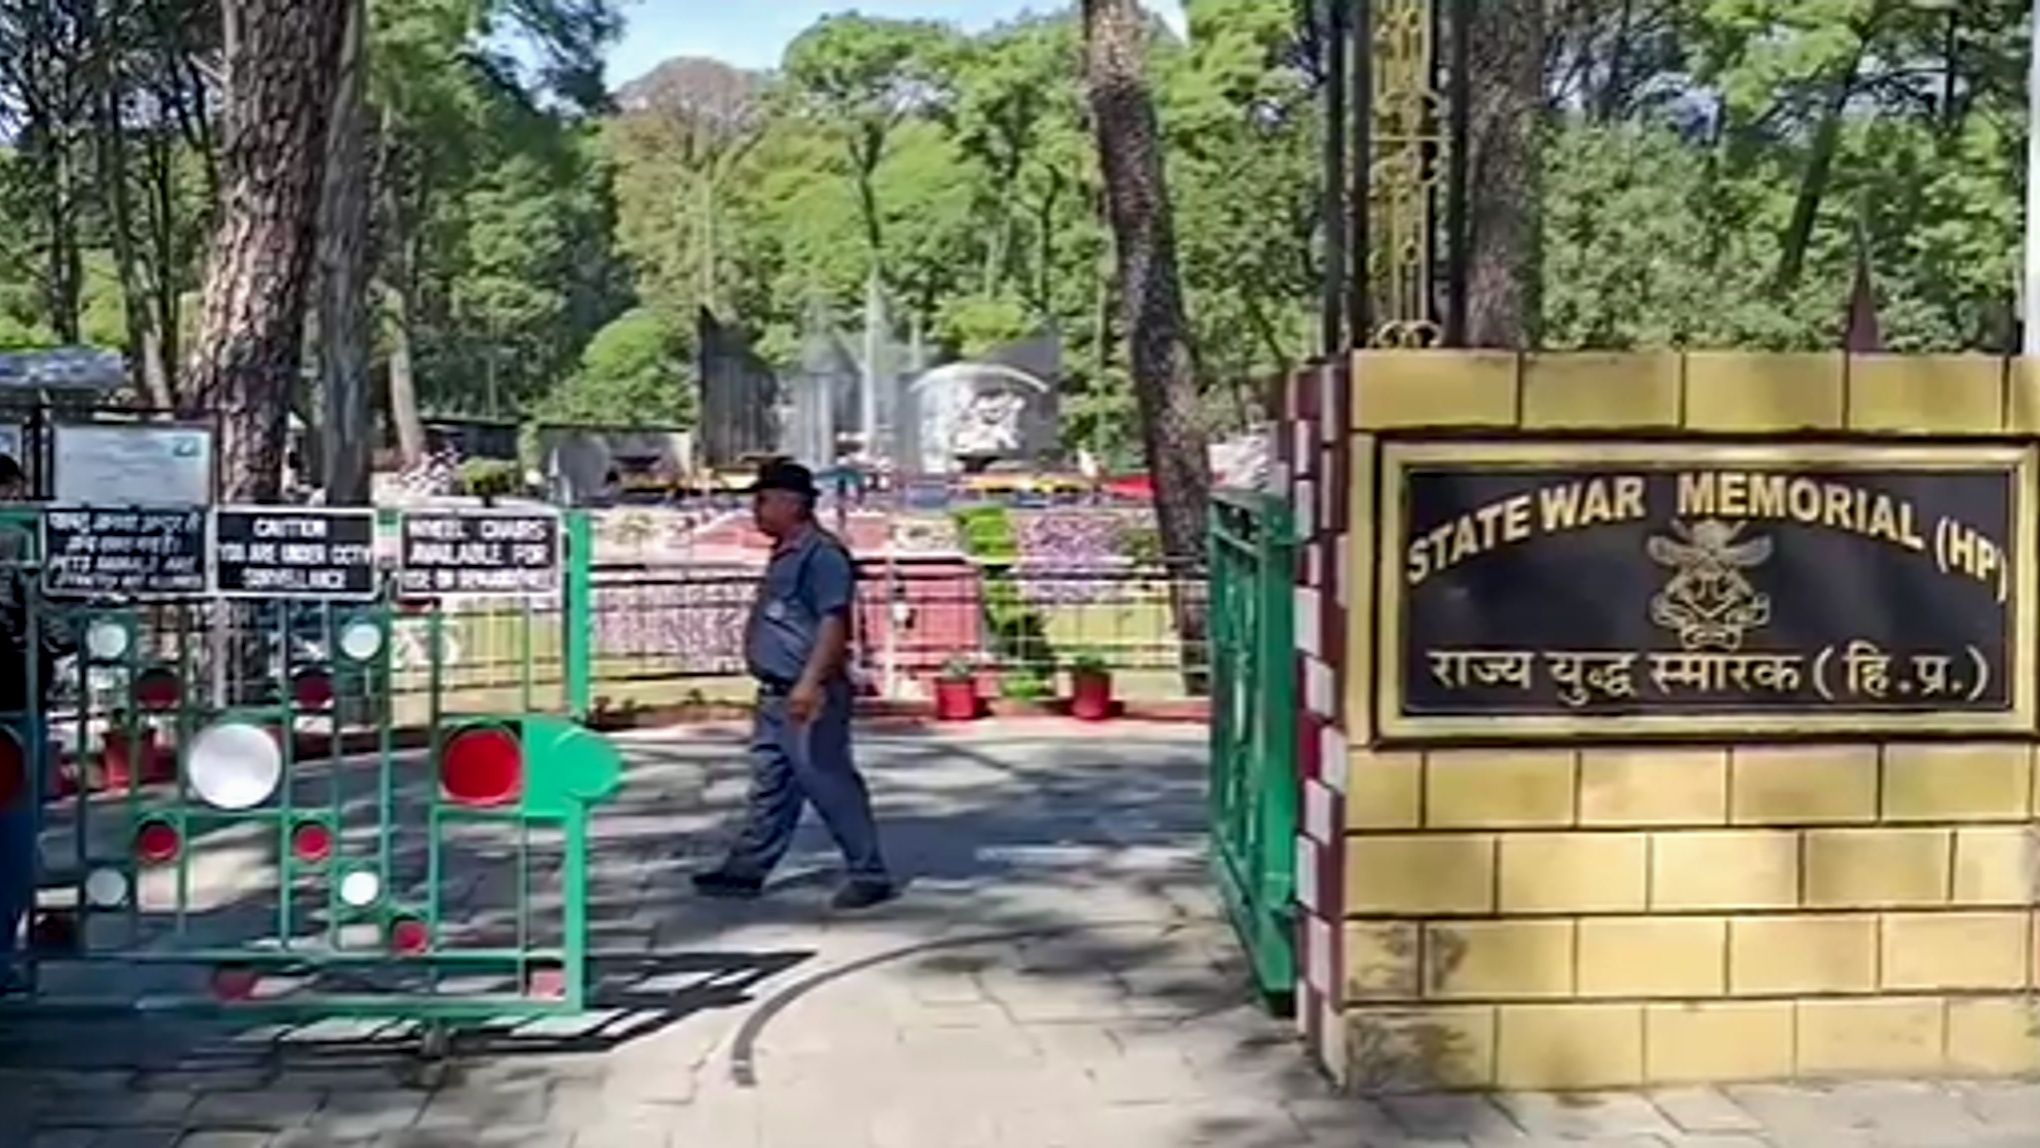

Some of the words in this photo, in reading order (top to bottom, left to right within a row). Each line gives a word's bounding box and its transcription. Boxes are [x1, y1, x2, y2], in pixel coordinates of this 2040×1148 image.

[1407, 496, 1531, 584] STATE
[1541, 475, 1646, 531] WAR
[1677, 471, 1925, 550] MEMORIAL
[1936, 517, 2009, 604] (HP)
[1427, 650, 1534, 689] राज्य
[1543, 652, 1639, 705] युद्ध
[1648, 653, 1804, 693] स्मारक
